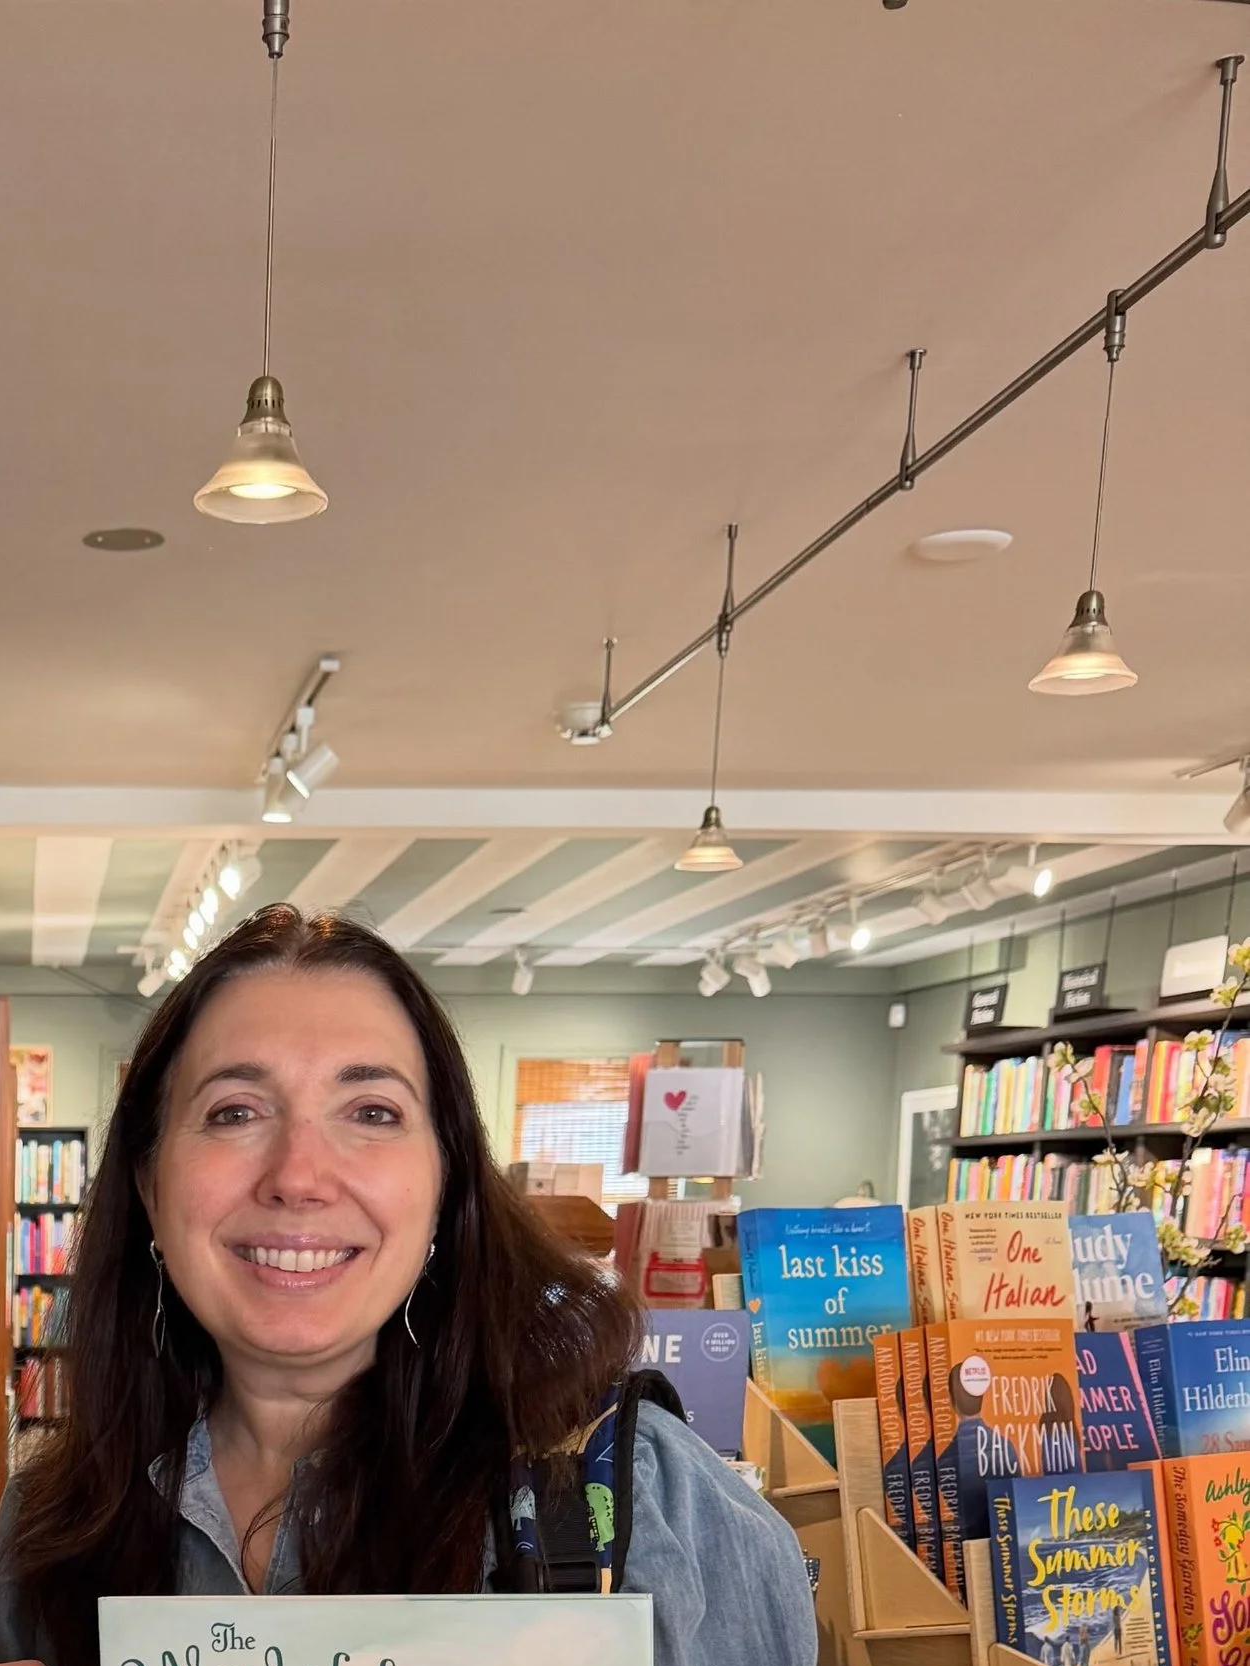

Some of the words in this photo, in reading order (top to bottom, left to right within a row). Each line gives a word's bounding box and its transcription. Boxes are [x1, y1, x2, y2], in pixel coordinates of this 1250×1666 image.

[779, 1245, 827, 1279] last
[832, 1244, 884, 1278] kiss
[1006, 1230, 1042, 1263] One
[824, 1287, 849, 1315] of
[983, 1273, 1066, 1313] Italian
[751, 1321, 764, 1346] last
[788, 1322, 892, 1349] summer
[877, 1346, 897, 1402] ANXIOUS
[903, 1341, 923, 1397] ANXIOUS
[929, 1336, 947, 1394] ANXIOUS
[1148, 1357, 1162, 1384] Elin
[1214, 1346, 1250, 1373] Elin
[991, 1374, 1057, 1417] FREDRIK
[882, 1402, 899, 1451] PEOPLE
[908, 1398, 927, 1449] PEOPLE
[934, 1397, 953, 1445] PEOPLE
[976, 1421, 1076, 1477] BACKMAN
[913, 1470, 933, 1522] FREDRIK
[939, 1467, 959, 1524] FREDRIK
[1172, 1466, 1187, 1490] The
[993, 1494, 1012, 1537] These
[1038, 1485, 1120, 1540] These
[1173, 1490, 1190, 1557] Someday
[996, 1536, 1015, 1592] Summer
[1027, 1538, 1142, 1587] Summer
[1041, 1584, 1144, 1633] Storms
[1181, 1560, 1195, 1617] Garden
[211, 1622, 256, 1653] The
[1001, 1593, 1018, 1645] Storms
